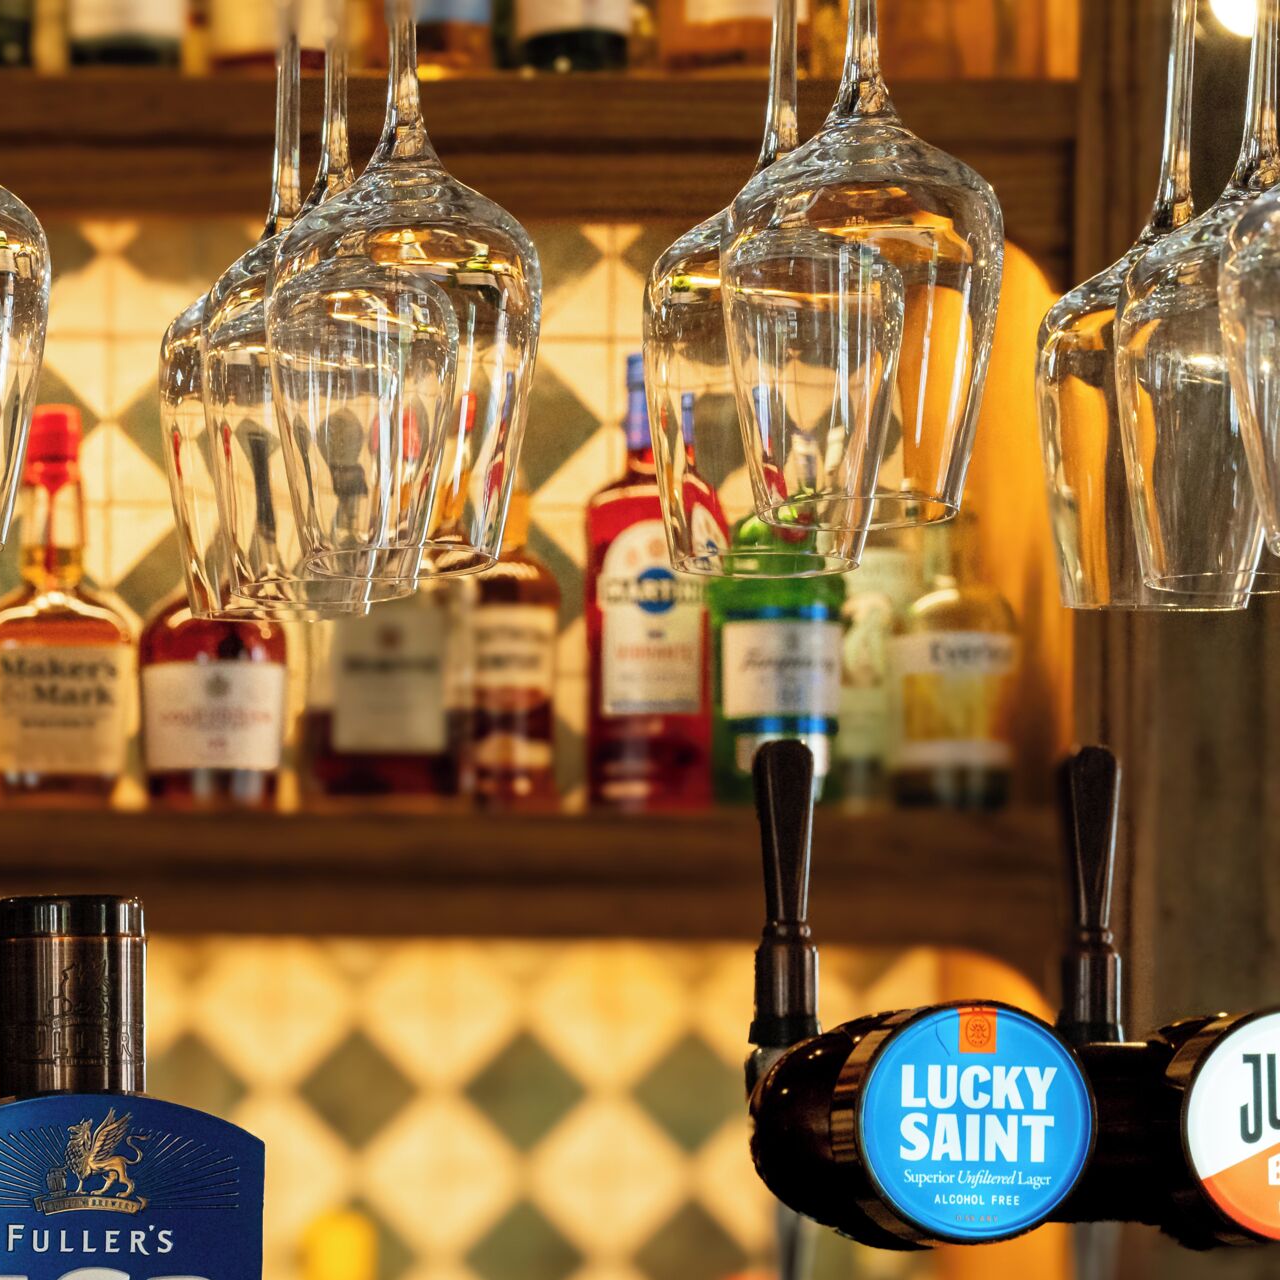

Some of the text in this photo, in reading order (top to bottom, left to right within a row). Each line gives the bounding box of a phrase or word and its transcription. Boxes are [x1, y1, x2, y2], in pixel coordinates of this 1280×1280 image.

[0, 656, 118, 680] Maker's
[33, 681, 116, 707] Mark
[900, 1063, 1058, 1110] LUCKY
[899, 1112, 1055, 1163] SAINT
[903, 1168, 1052, 1190] Superior Unfiltered Lager
[934, 1193, 1020, 1206] ALCOHOL FREE
[7, 1223, 174, 1256] FULLER'S
